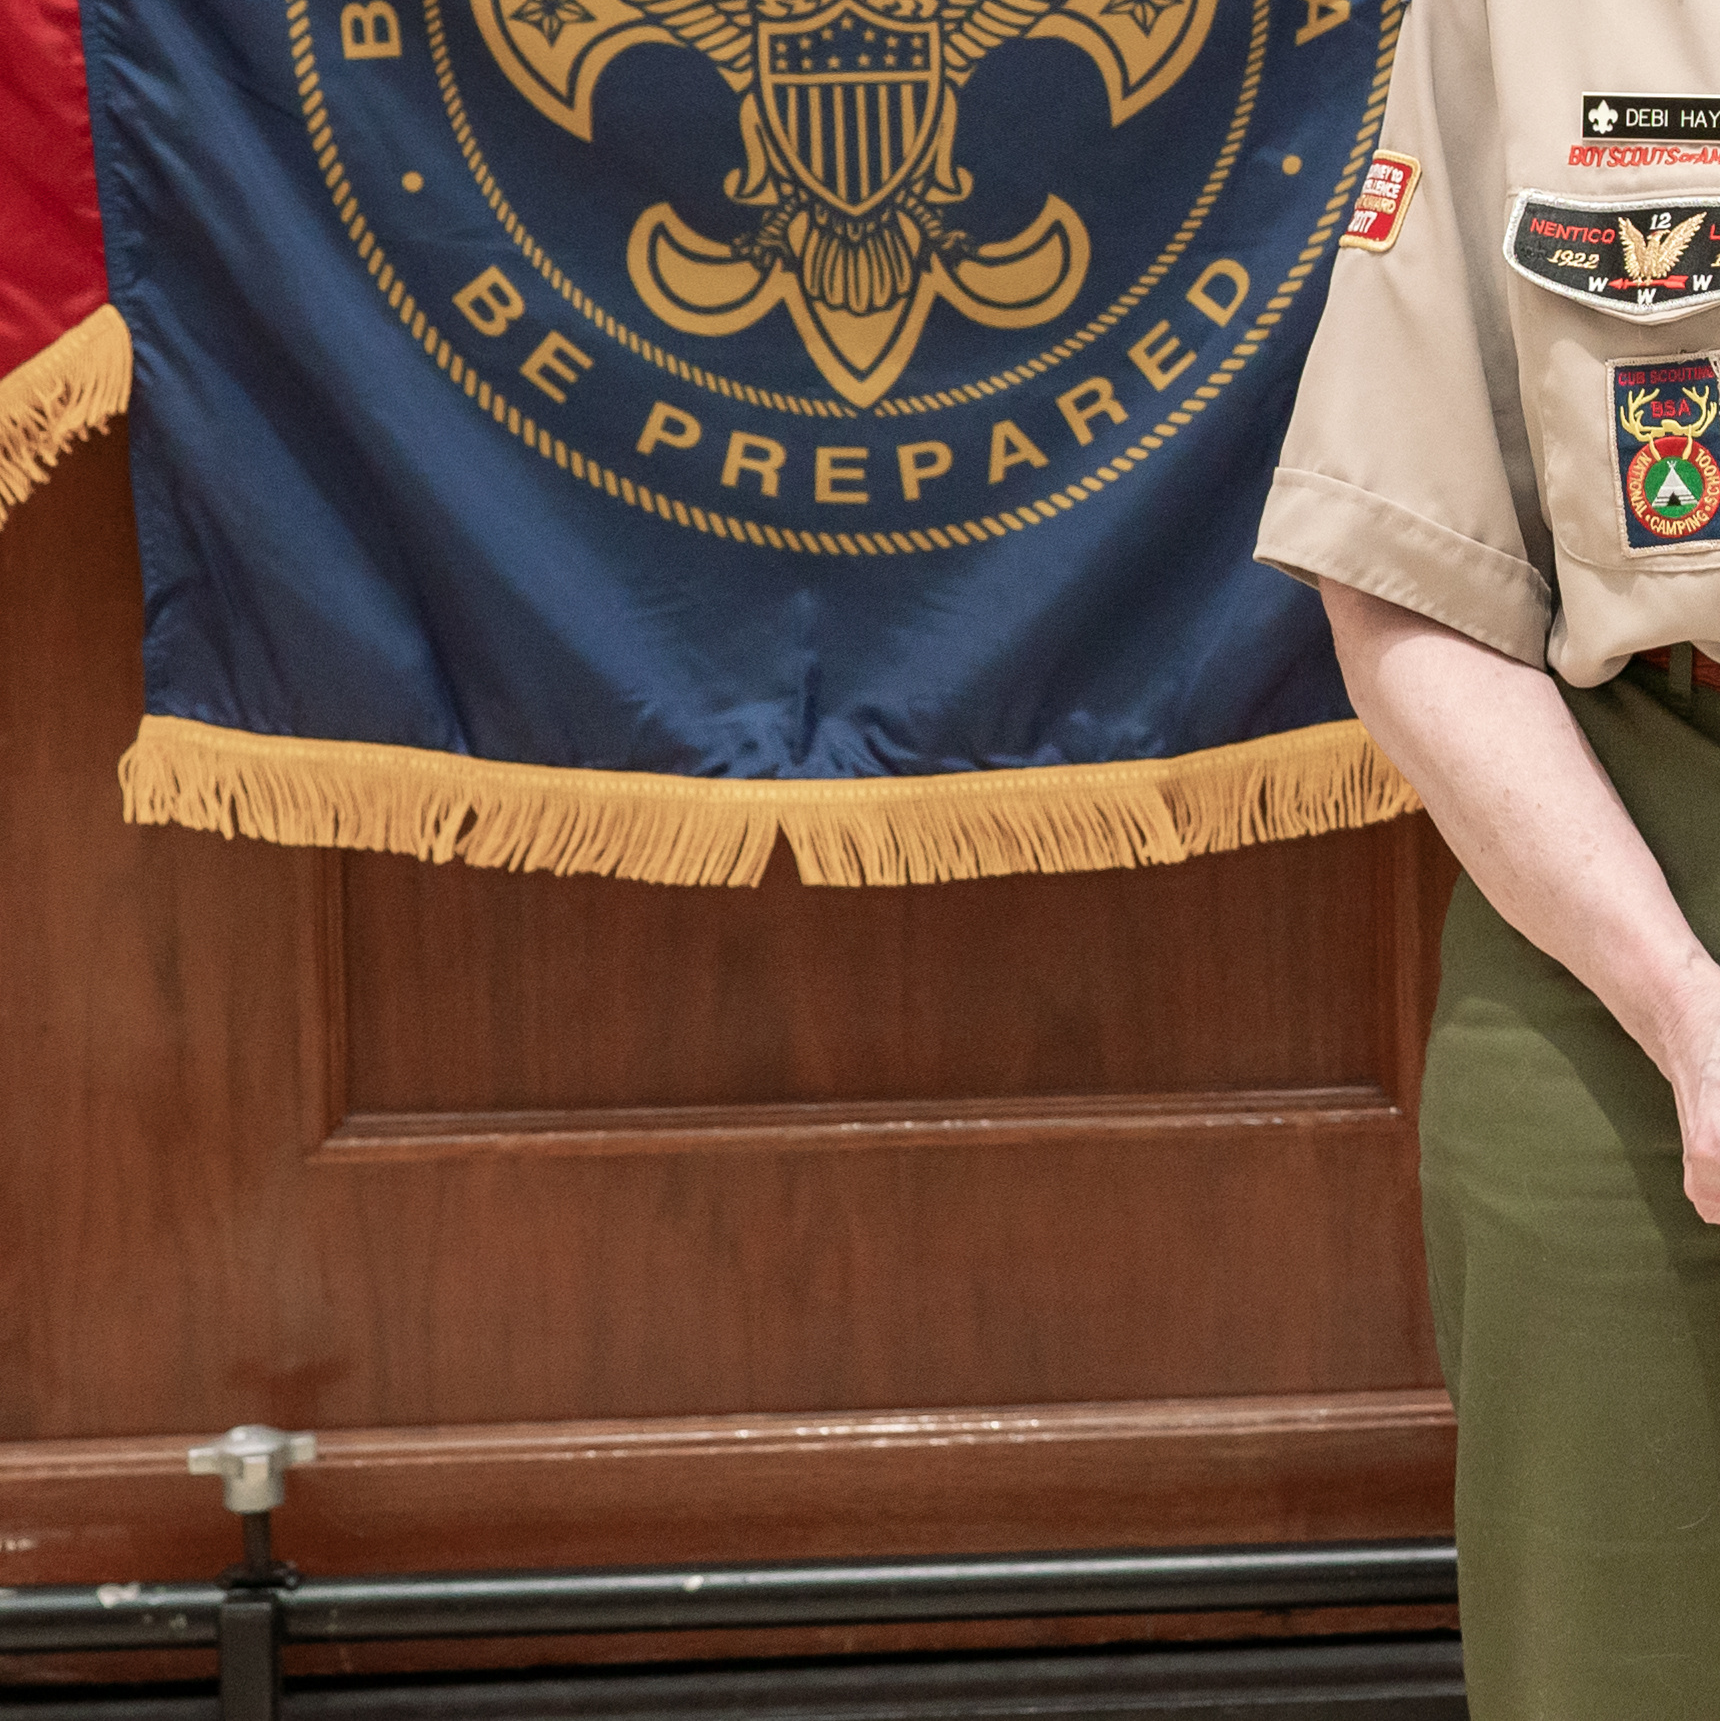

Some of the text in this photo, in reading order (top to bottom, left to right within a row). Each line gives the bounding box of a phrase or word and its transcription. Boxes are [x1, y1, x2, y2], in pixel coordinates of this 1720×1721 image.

[1626, 108, 1669, 127] DEBI
[1568, 145, 1606, 167] BOY
[1606, 146, 1680, 167] SCOUTS
[1530, 218, 1615, 244] NENTICO
[1650, 212, 1672, 229] 12
[1548, 249, 1600, 269] 1922
[1588, 275, 1712, 304] W W W
[451, 257, 1252, 504] BE PREPARED
[1618, 365, 1715, 386] CUB SCOUTING
[1651, 399, 1691, 418] BSA
[1629, 448, 1720, 536] NATIONAL CAMPING SCHOOL
